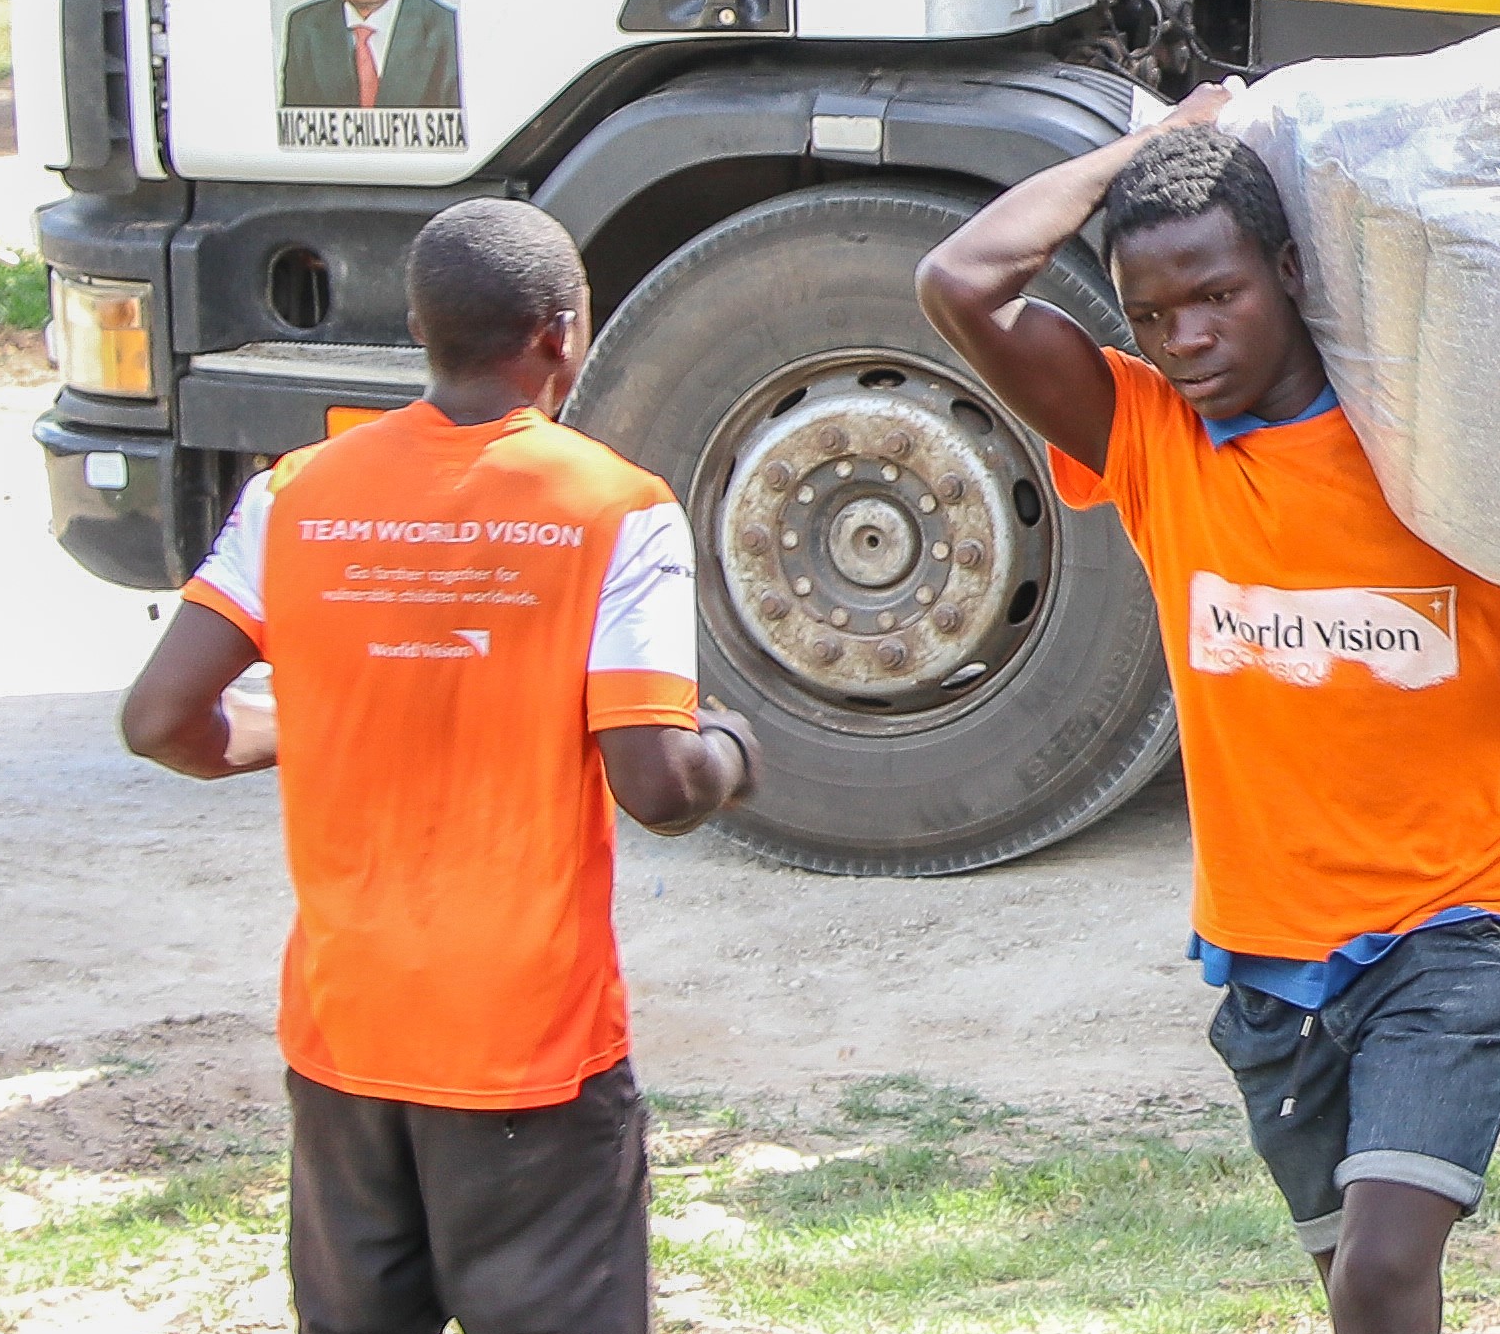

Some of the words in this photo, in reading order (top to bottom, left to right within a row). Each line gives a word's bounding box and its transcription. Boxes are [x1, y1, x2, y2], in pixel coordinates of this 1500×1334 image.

[278, 111, 339, 147] MICHAE
[343, 111, 422, 148] CHILUFYA
[425, 111, 468, 147] SATA
[297, 519, 372, 542] TEAM
[374, 520, 483, 544] WORLD
[485, 520, 585, 548] VISION
[1210, 604, 1305, 650] World
[1312, 617, 1421, 652] Vision
